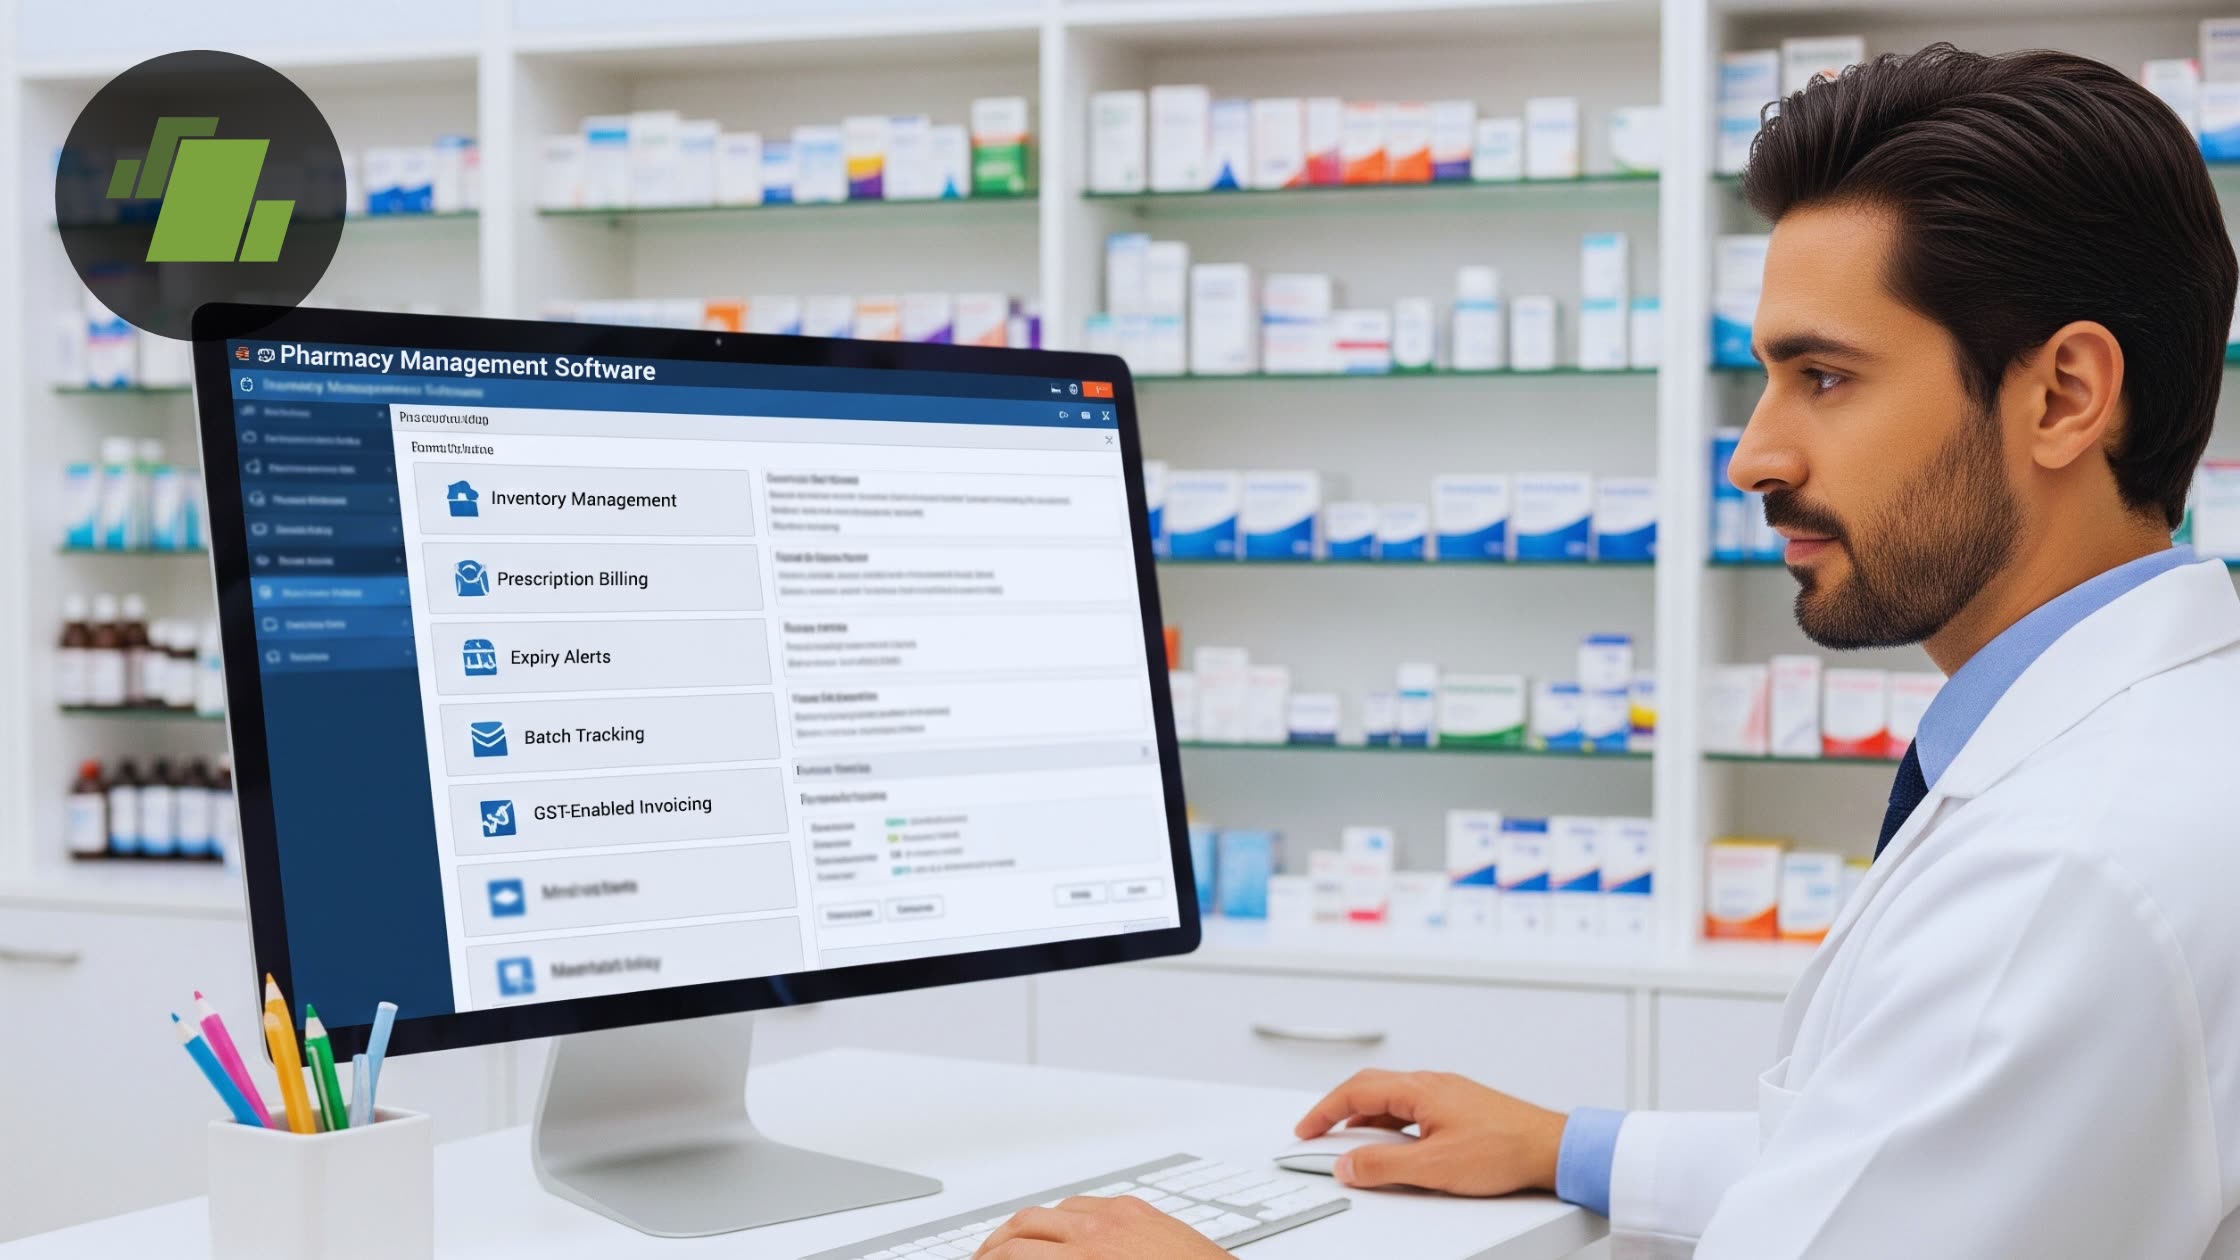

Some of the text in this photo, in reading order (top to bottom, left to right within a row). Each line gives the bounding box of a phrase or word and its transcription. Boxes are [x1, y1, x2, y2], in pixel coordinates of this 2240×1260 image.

[281, 343, 656, 381] Pharmacy Management Software
[491, 490, 677, 511] Inventory Management
[497, 570, 648, 590] Prescription Billing
[511, 648, 611, 668] Expiry Alerts
[524, 725, 645, 745] Batch Tracking
[534, 795, 712, 821] GST-Enabled Invoicing
